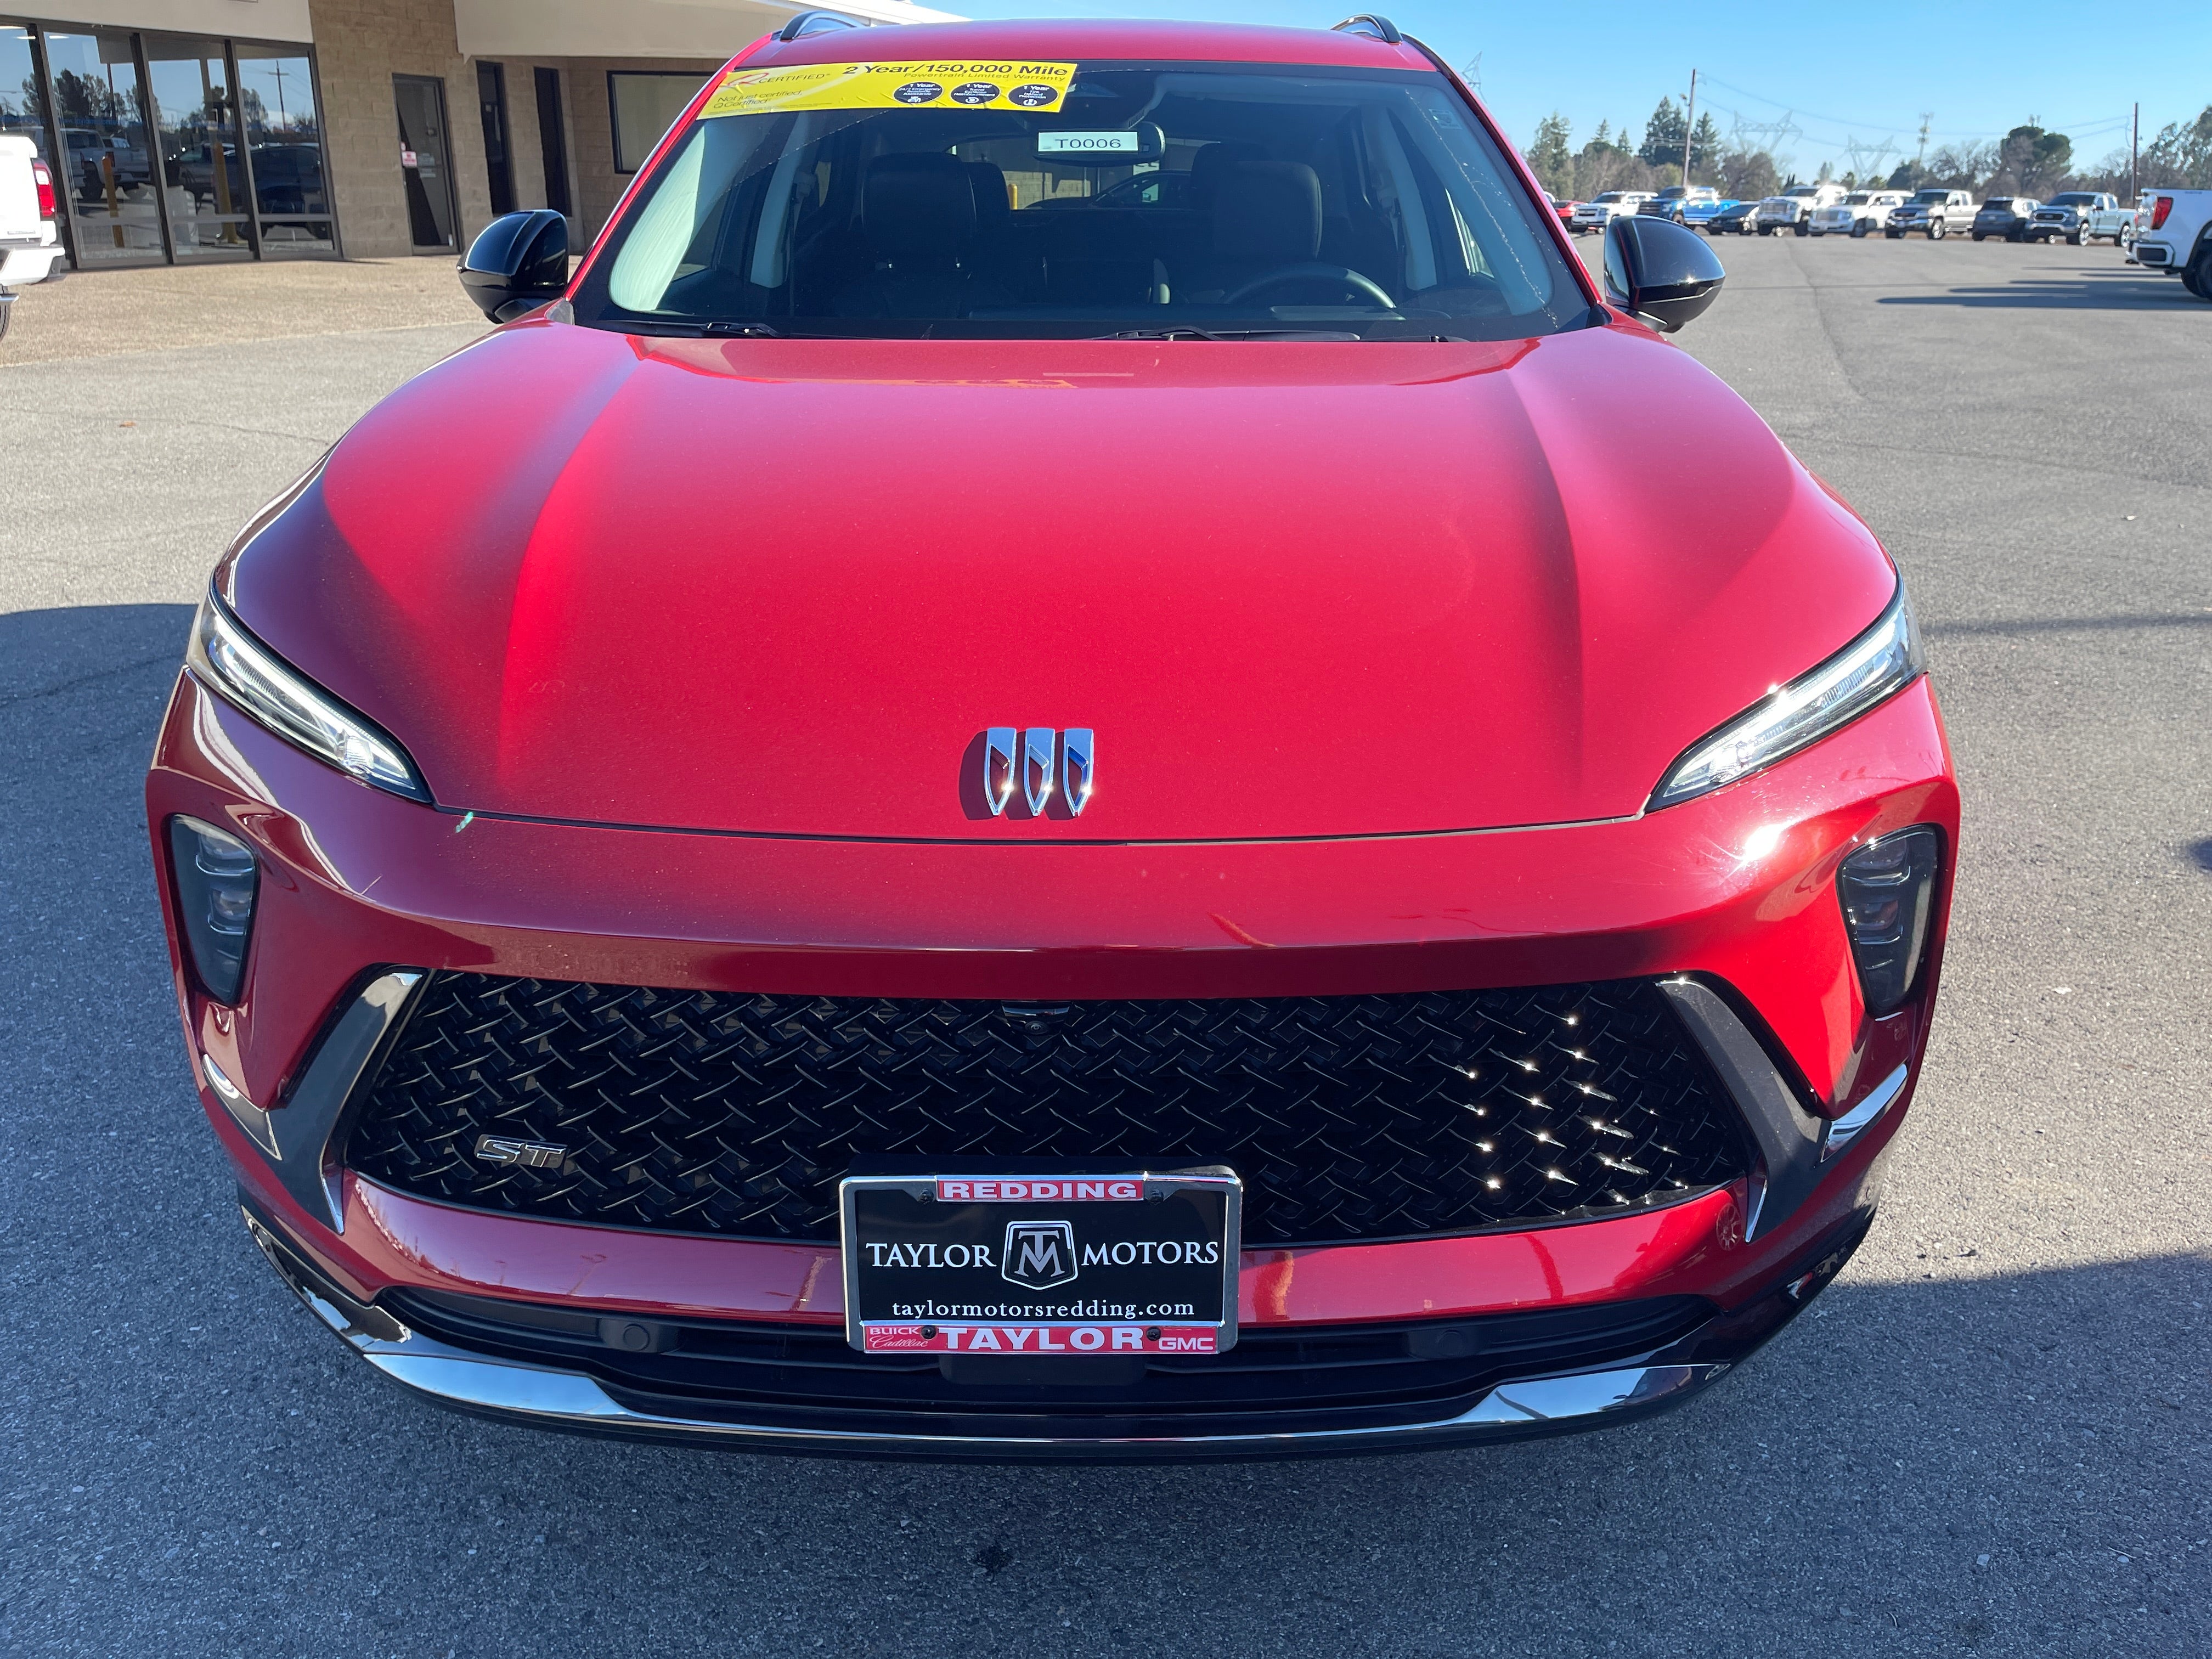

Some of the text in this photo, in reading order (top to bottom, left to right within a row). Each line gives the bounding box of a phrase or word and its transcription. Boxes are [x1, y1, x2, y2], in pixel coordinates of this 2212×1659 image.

[842, 64, 1068, 76] 2 Year/150,000 Mile
[1054, 139, 1121, 148] T0006
[476, 1139, 567, 1167] ST
[943, 1182, 1137, 1199] REDDING
[865, 1243, 997, 1268] TAYLOR
[1081, 1241, 1219, 1267] MOTORS
[892, 1300, 1195, 1320] taylormotorsredding.com
[870, 1327, 922, 1335] BUICK
[935, 1327, 1144, 1350] TAYLOR
[870, 1335, 929, 1348] Cadillac
[1158, 1337, 1214, 1350] GMC
